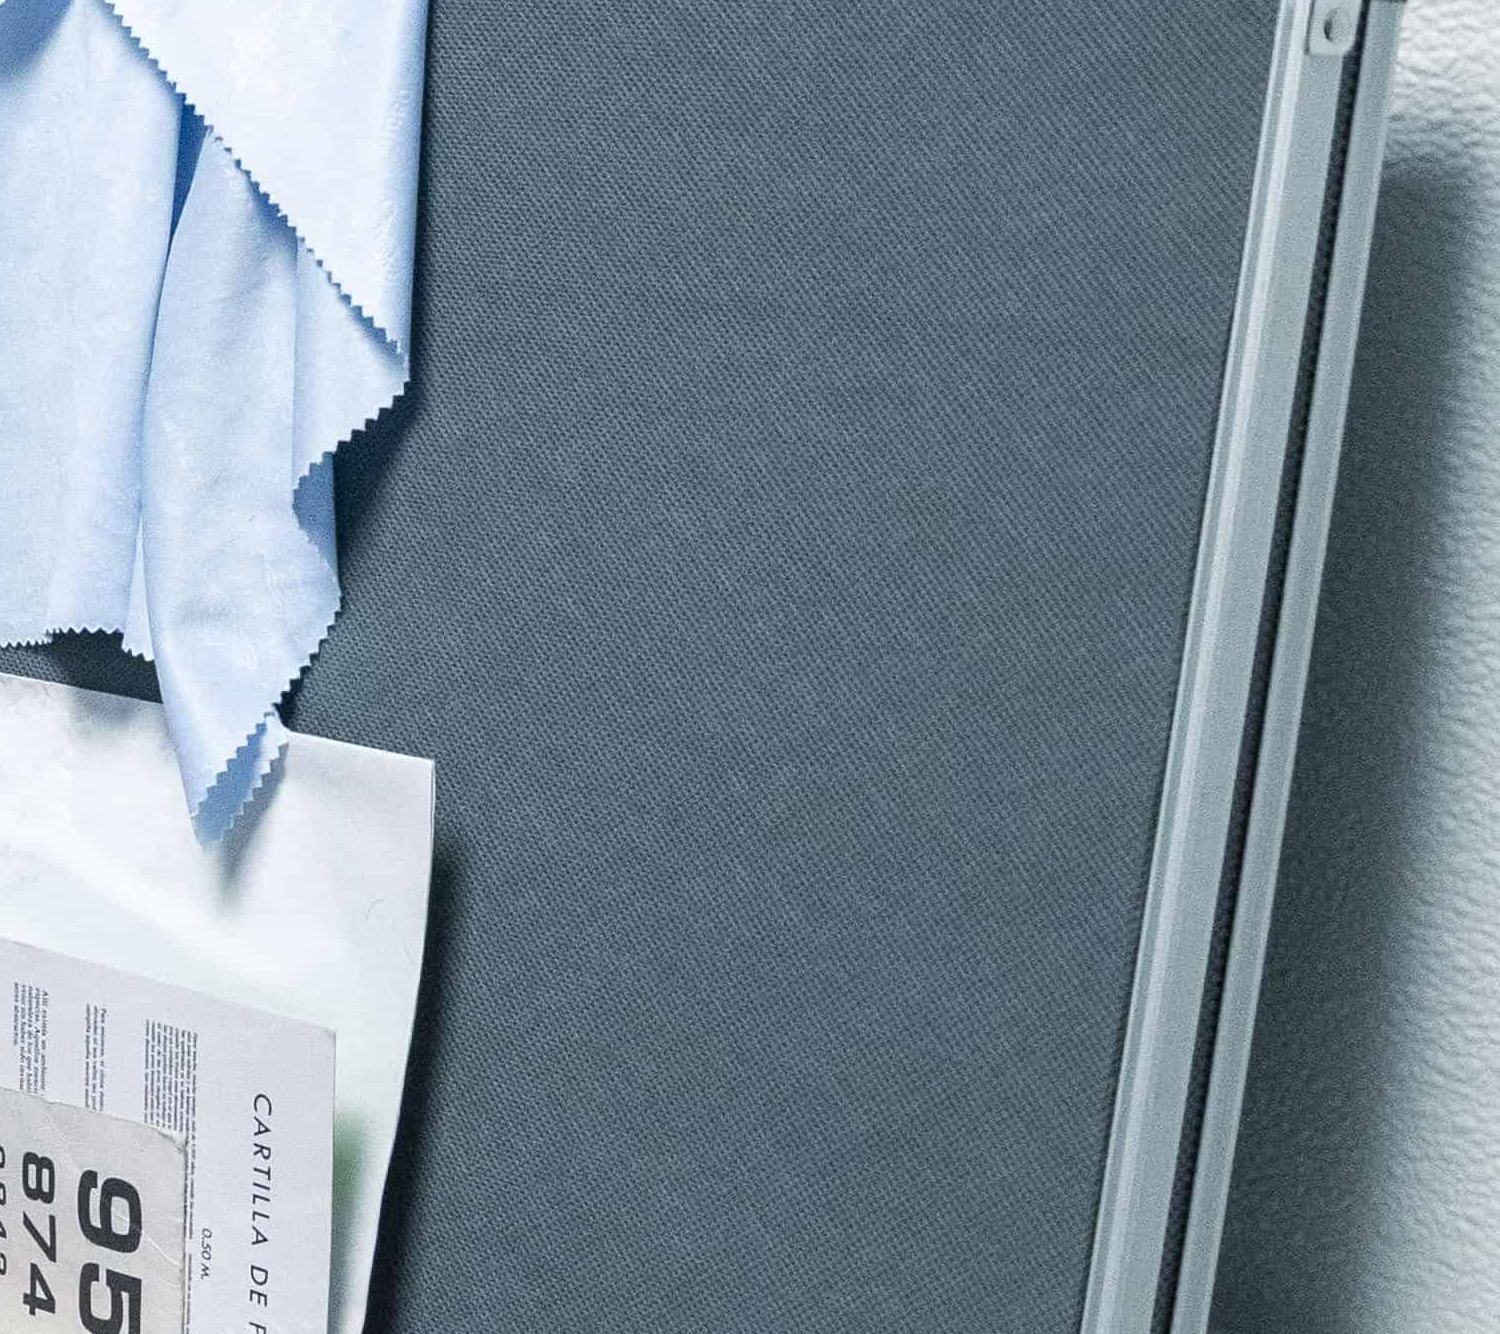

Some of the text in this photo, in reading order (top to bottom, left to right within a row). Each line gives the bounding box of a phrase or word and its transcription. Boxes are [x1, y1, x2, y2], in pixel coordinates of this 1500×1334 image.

[251, 1093, 272, 1245] CARTILLA
[22, 1151, 57, 1316] 874
[201, 1228, 212, 1280] 0.50 M.
[249, 1265, 268, 1307] DE
